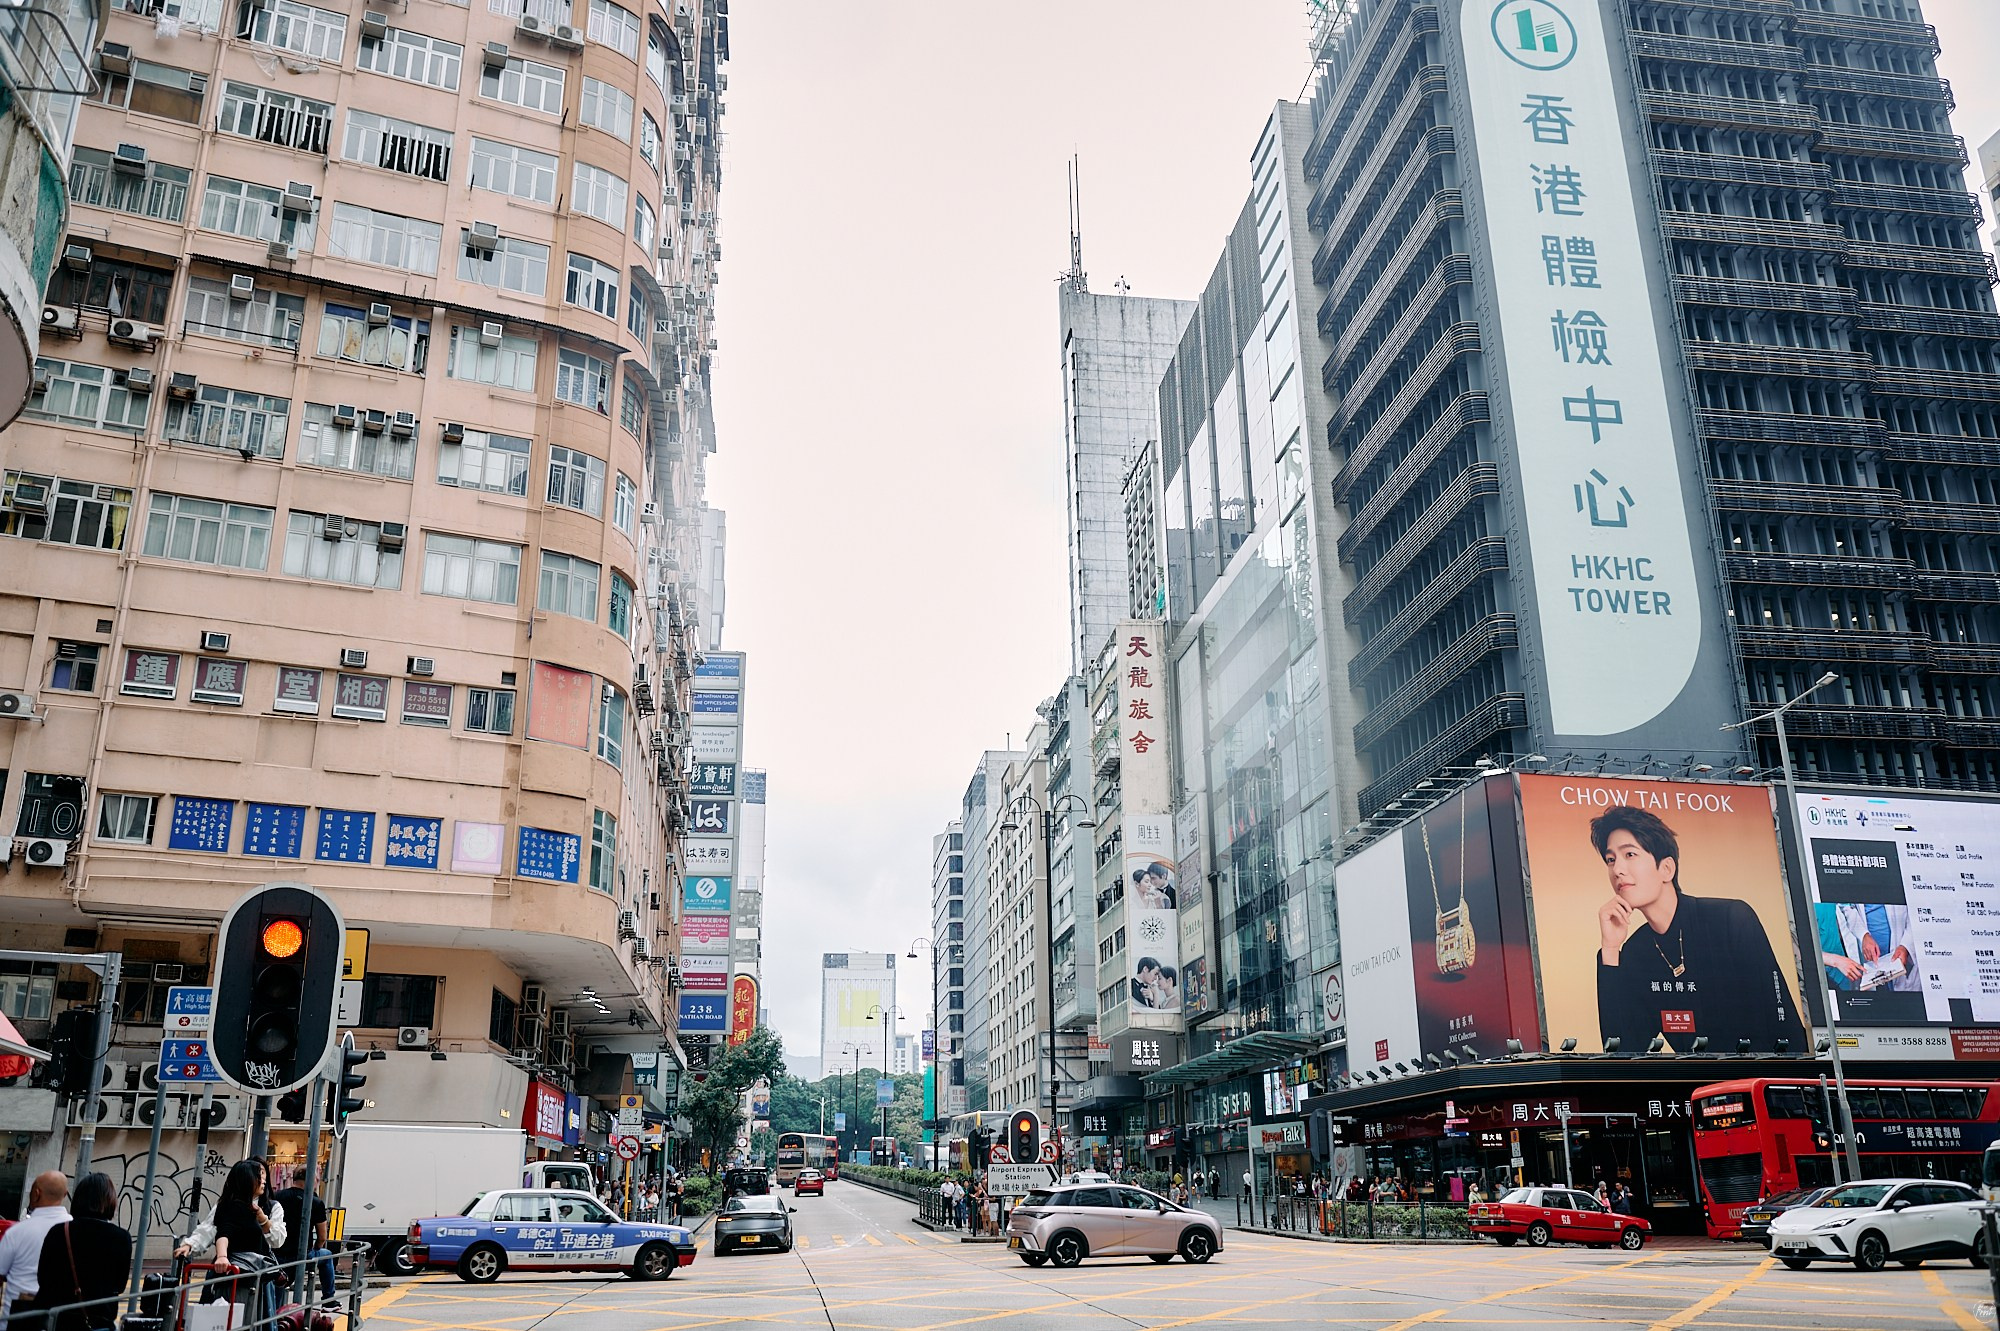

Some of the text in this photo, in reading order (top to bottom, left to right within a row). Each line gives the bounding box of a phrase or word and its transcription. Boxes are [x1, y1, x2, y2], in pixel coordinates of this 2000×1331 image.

[1521, 93, 1635, 529] 香港體檢中心
[1571, 554, 1654, 583] HKHC
[1567, 587, 1672, 615] TOWER
[419, 686, 437, 696] 電話
[1126, 636, 1156, 753] 天龍旅舍
[408, 694, 447, 705] 2730 5518
[407, 703, 446, 714] 2730 5528
[1560, 786, 1734, 813] CHOW TAI FOOK
[696, 803, 723, 828] は
[1824, 808, 1847, 818] HKHC
[1137, 824, 1161, 839] 周生生
[1821, 853, 1888, 868] 身體檢查計劃項目
[1934, 884, 1955, 892] Screening
[1351, 946, 1401, 977] CHOW TAI FOOK
[1650, 981, 1697, 992] 福的傳承
[690, 1005, 712, 1014] 238
[1665, 1013, 1691, 1023] 周大福
[1457, 1030, 1477, 1043] Collection
[1901, 1038, 1923, 1046] 3588
[1925, 1038, 1947, 1046] 8288
[1131, 1040, 1160, 1058] 周生生
[1512, 1101, 1571, 1122] 周大福
[1083, 1115, 1107, 1131] 周生生
[517, 1228, 557, 1239] 高德Call
[533, 1239, 555, 1250] 的士
